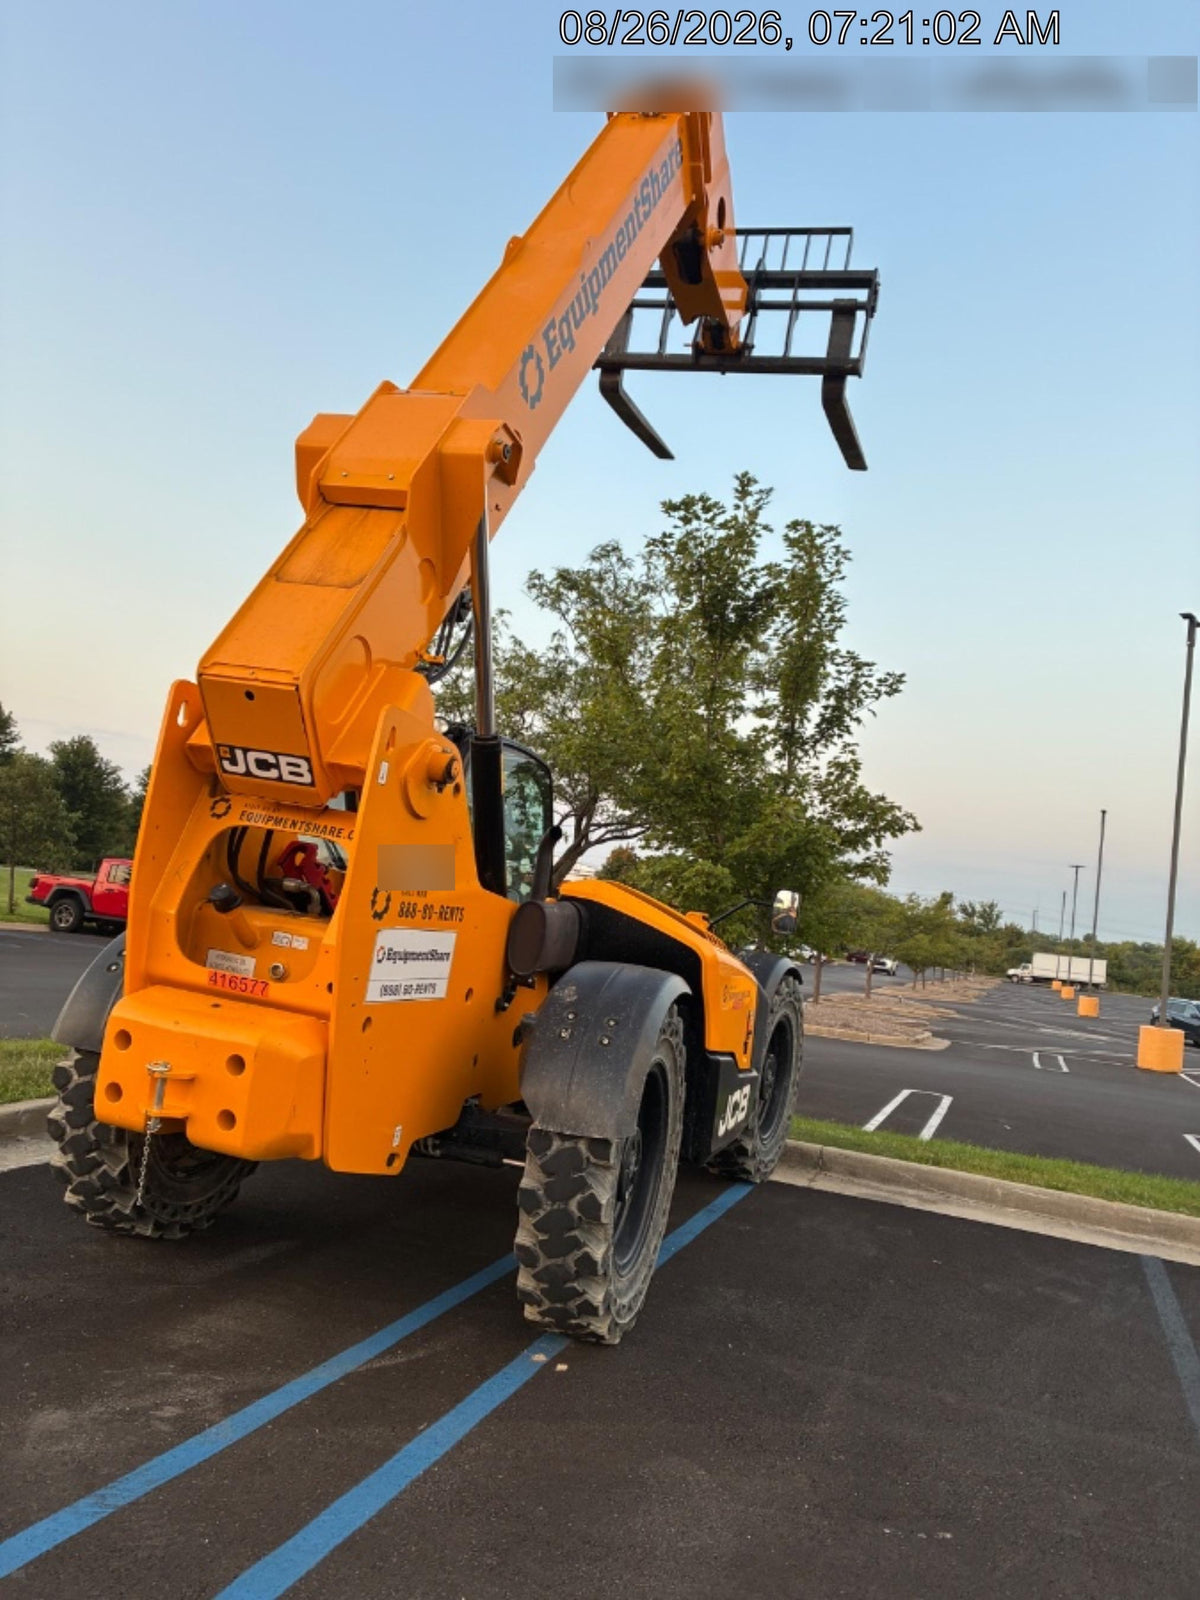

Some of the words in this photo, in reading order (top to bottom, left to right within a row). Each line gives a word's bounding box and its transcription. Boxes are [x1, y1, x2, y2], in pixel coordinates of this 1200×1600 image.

[541, 136, 683, 371] EquipmentShare
[221, 747, 313, 785] JCB
[209, 971, 269, 996] 416577
[717, 1084, 751, 1137] JCB
